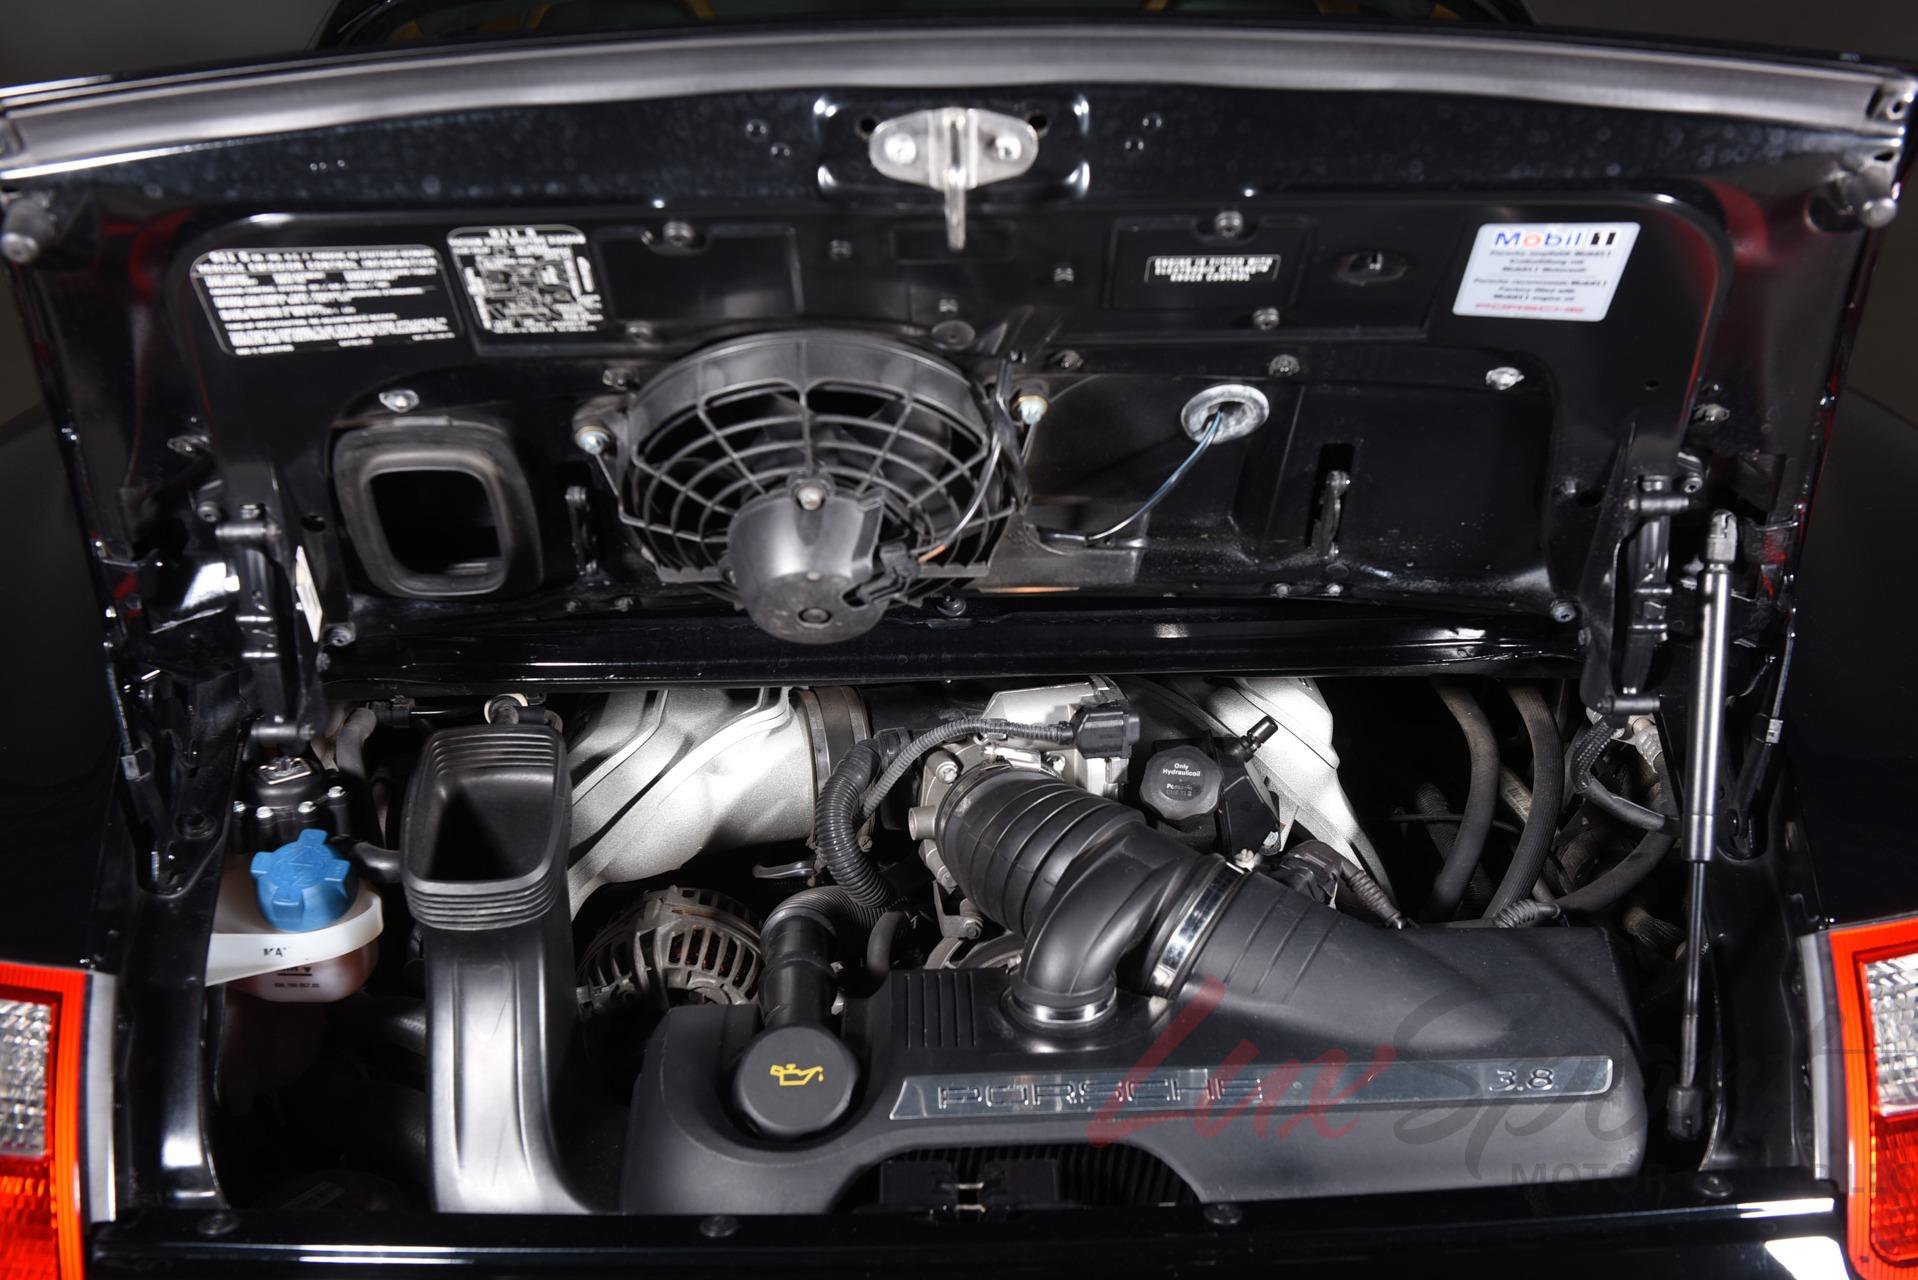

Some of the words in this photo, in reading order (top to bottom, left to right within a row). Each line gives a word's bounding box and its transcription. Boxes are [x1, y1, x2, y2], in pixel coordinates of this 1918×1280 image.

[1494, 232, 1581, 247] Mobil
[938, 1078, 1263, 1109] PORSCHE
[1489, 1068, 1554, 1091] 3.8
